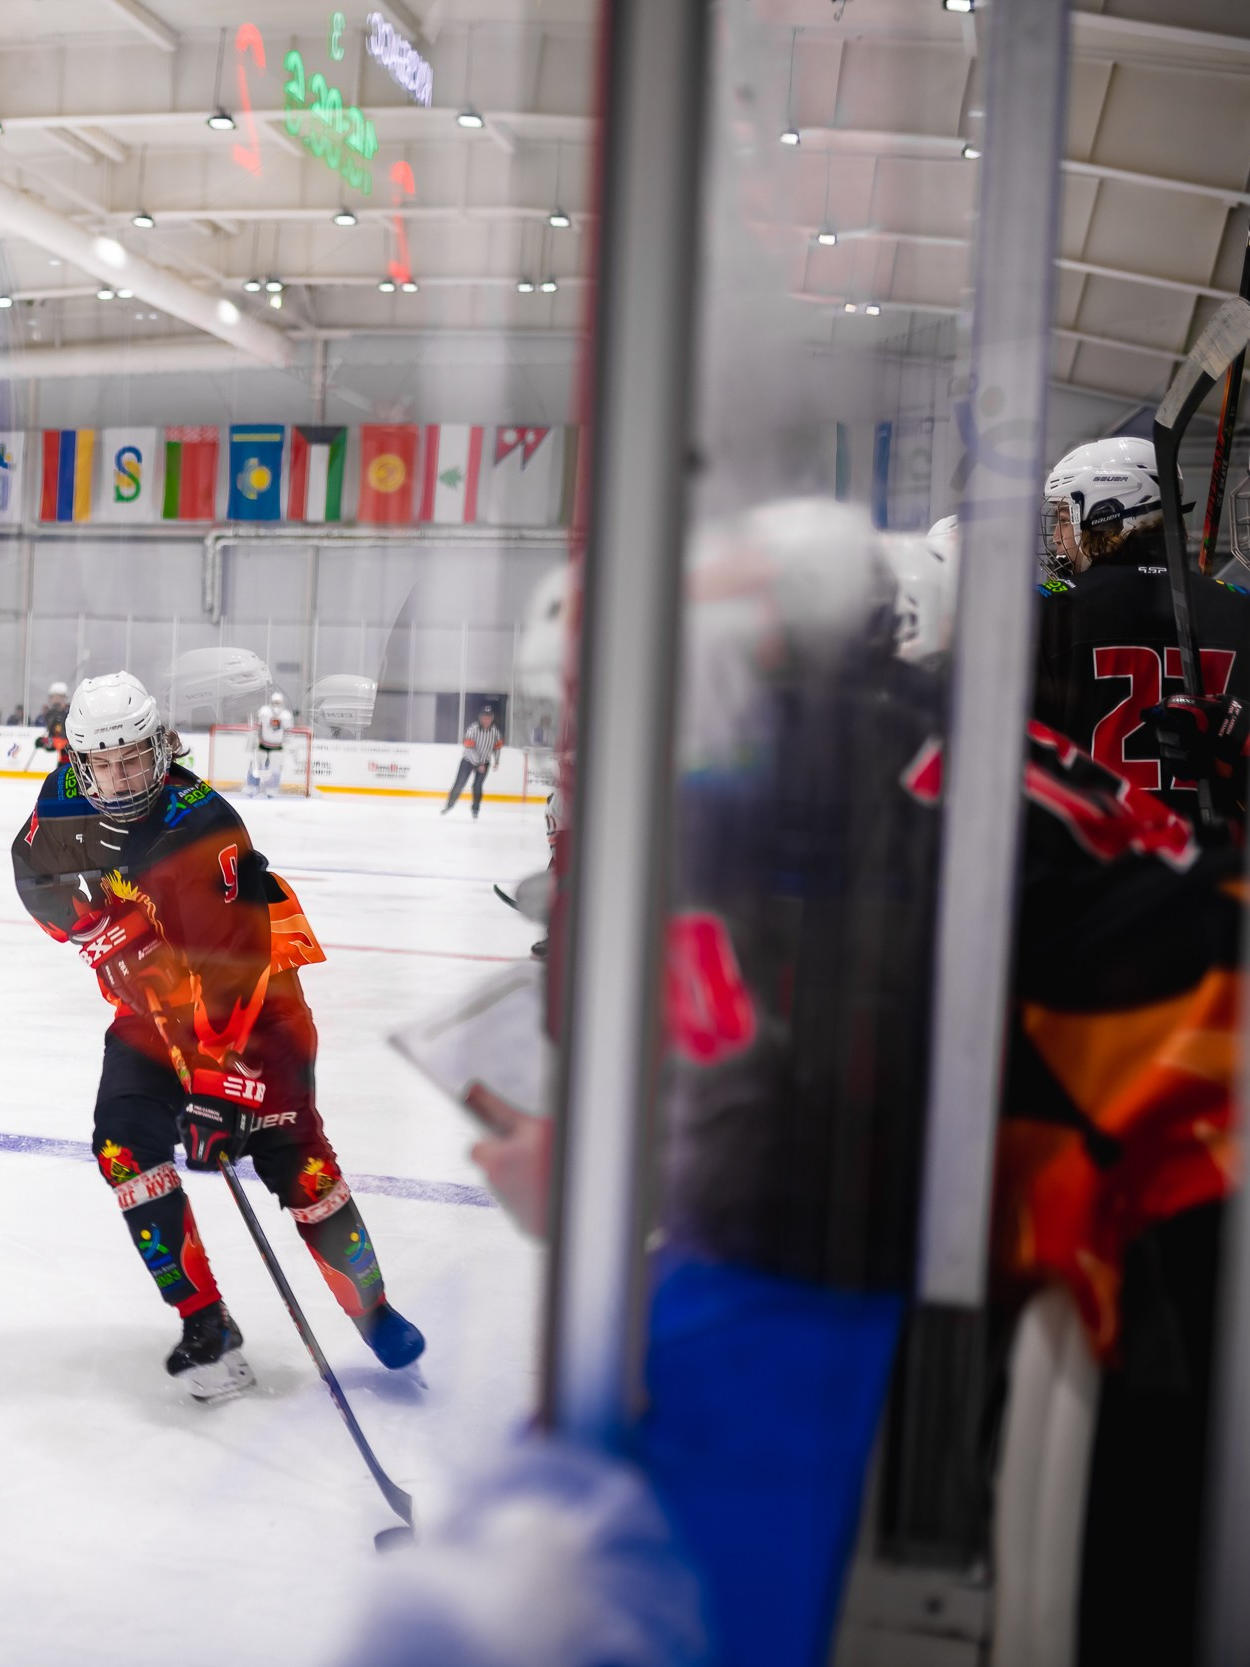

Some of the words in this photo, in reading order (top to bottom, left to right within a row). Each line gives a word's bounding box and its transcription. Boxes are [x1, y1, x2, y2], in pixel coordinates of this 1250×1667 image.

[1091, 512, 1121, 526] BAUER
[217, 843, 239, 904] 9
[250, 1111, 298, 1132] UER
